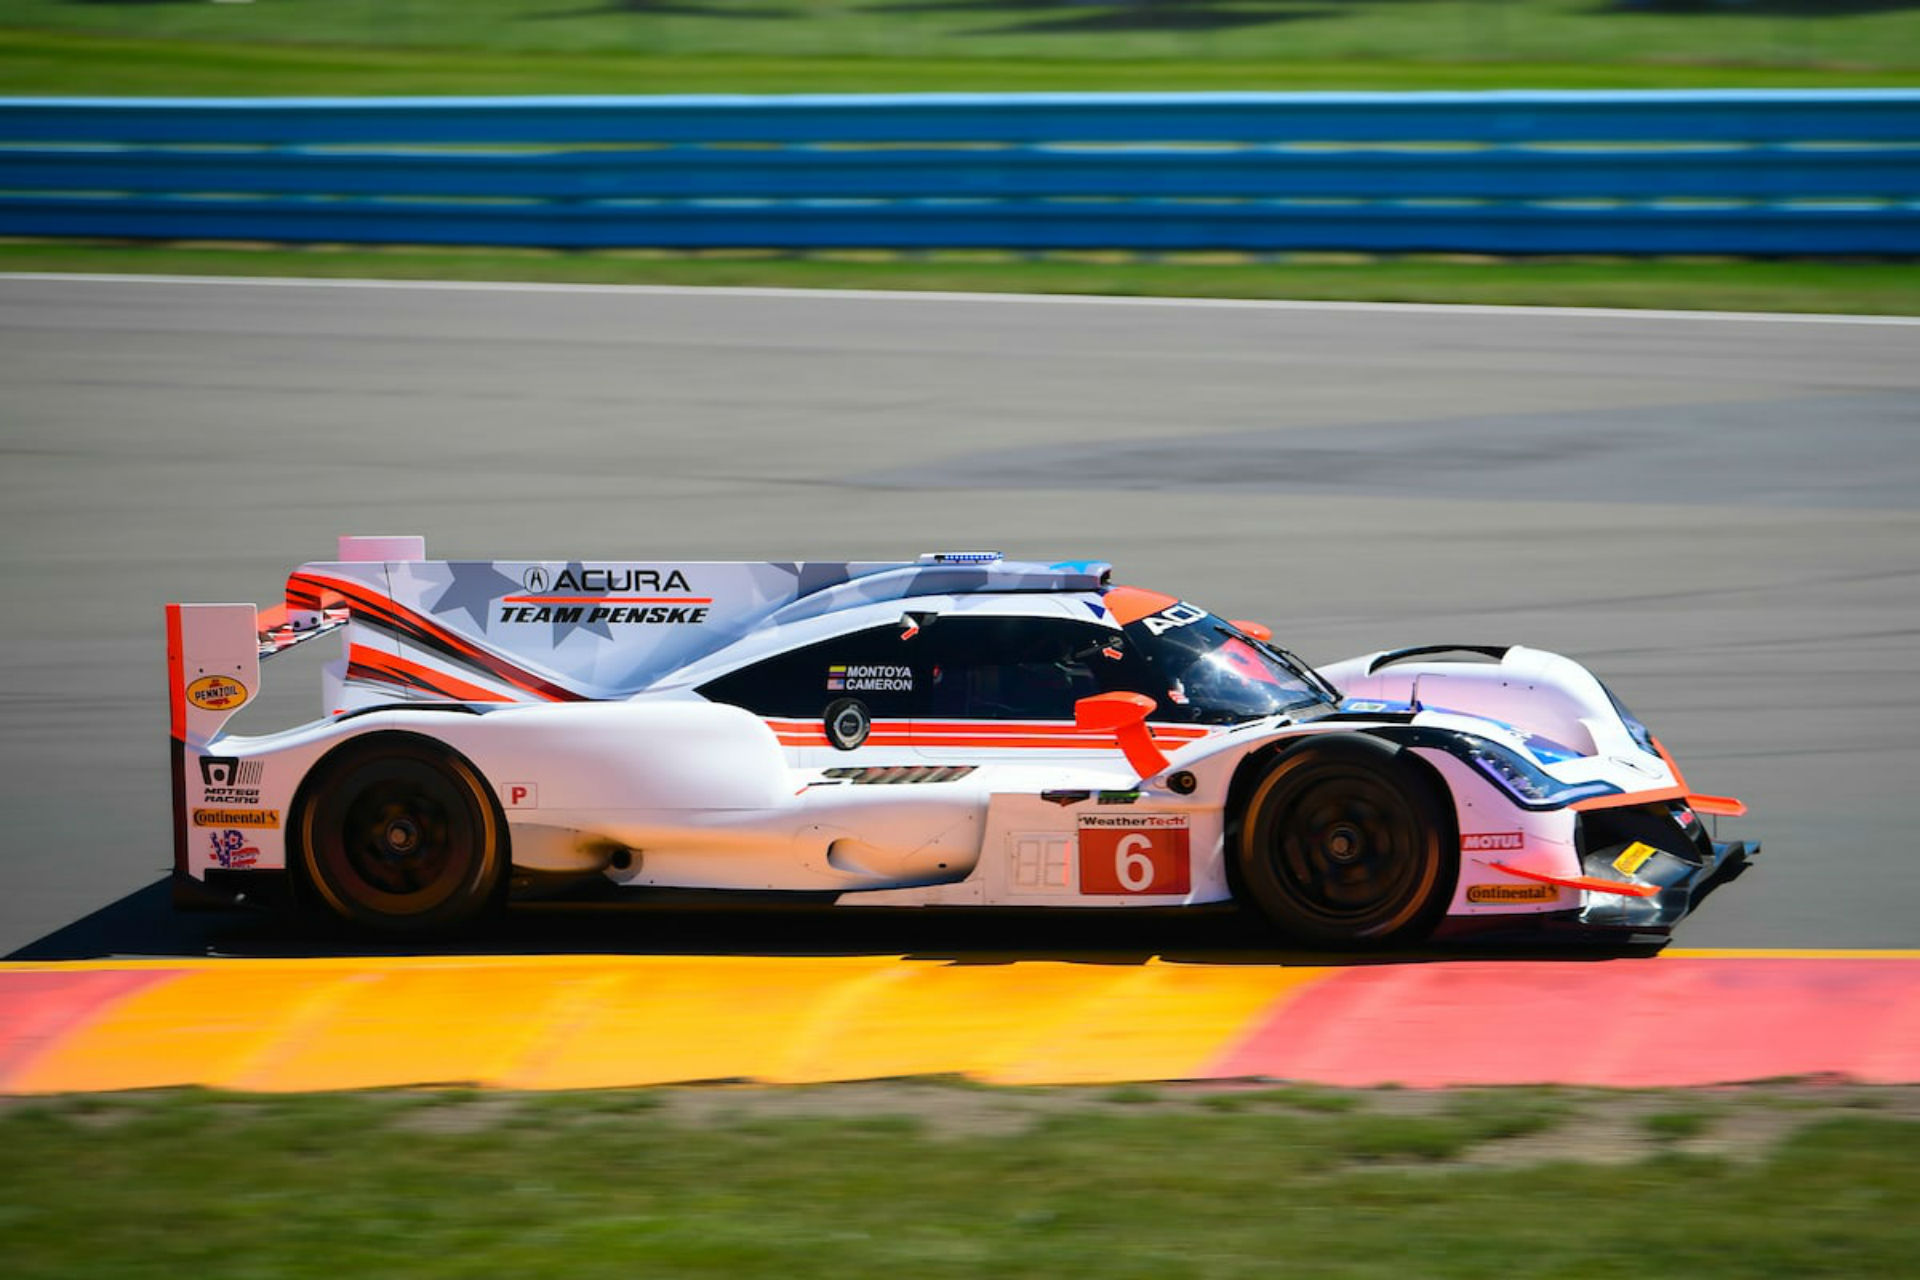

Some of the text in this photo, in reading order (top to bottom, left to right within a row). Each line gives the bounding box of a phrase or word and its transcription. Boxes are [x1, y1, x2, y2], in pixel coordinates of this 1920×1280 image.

[552, 569, 691, 592] ACURA
[500, 607, 709, 623] TEAM PENSKE
[846, 665, 912, 678] MONTOYA
[194, 684, 238, 701] PENNZOIL
[846, 678, 913, 692] CAMERON
[204, 787, 260, 796] MOTEGI
[511, 786, 527, 805] P
[204, 796, 260, 804] RACING
[193, 809, 265, 827] Continental
[1082, 815, 1186, 826] WeatherTech
[1464, 834, 1522, 849] MOTUL
[1115, 833, 1155, 892] 6
[1466, 885, 1546, 903] Continental
